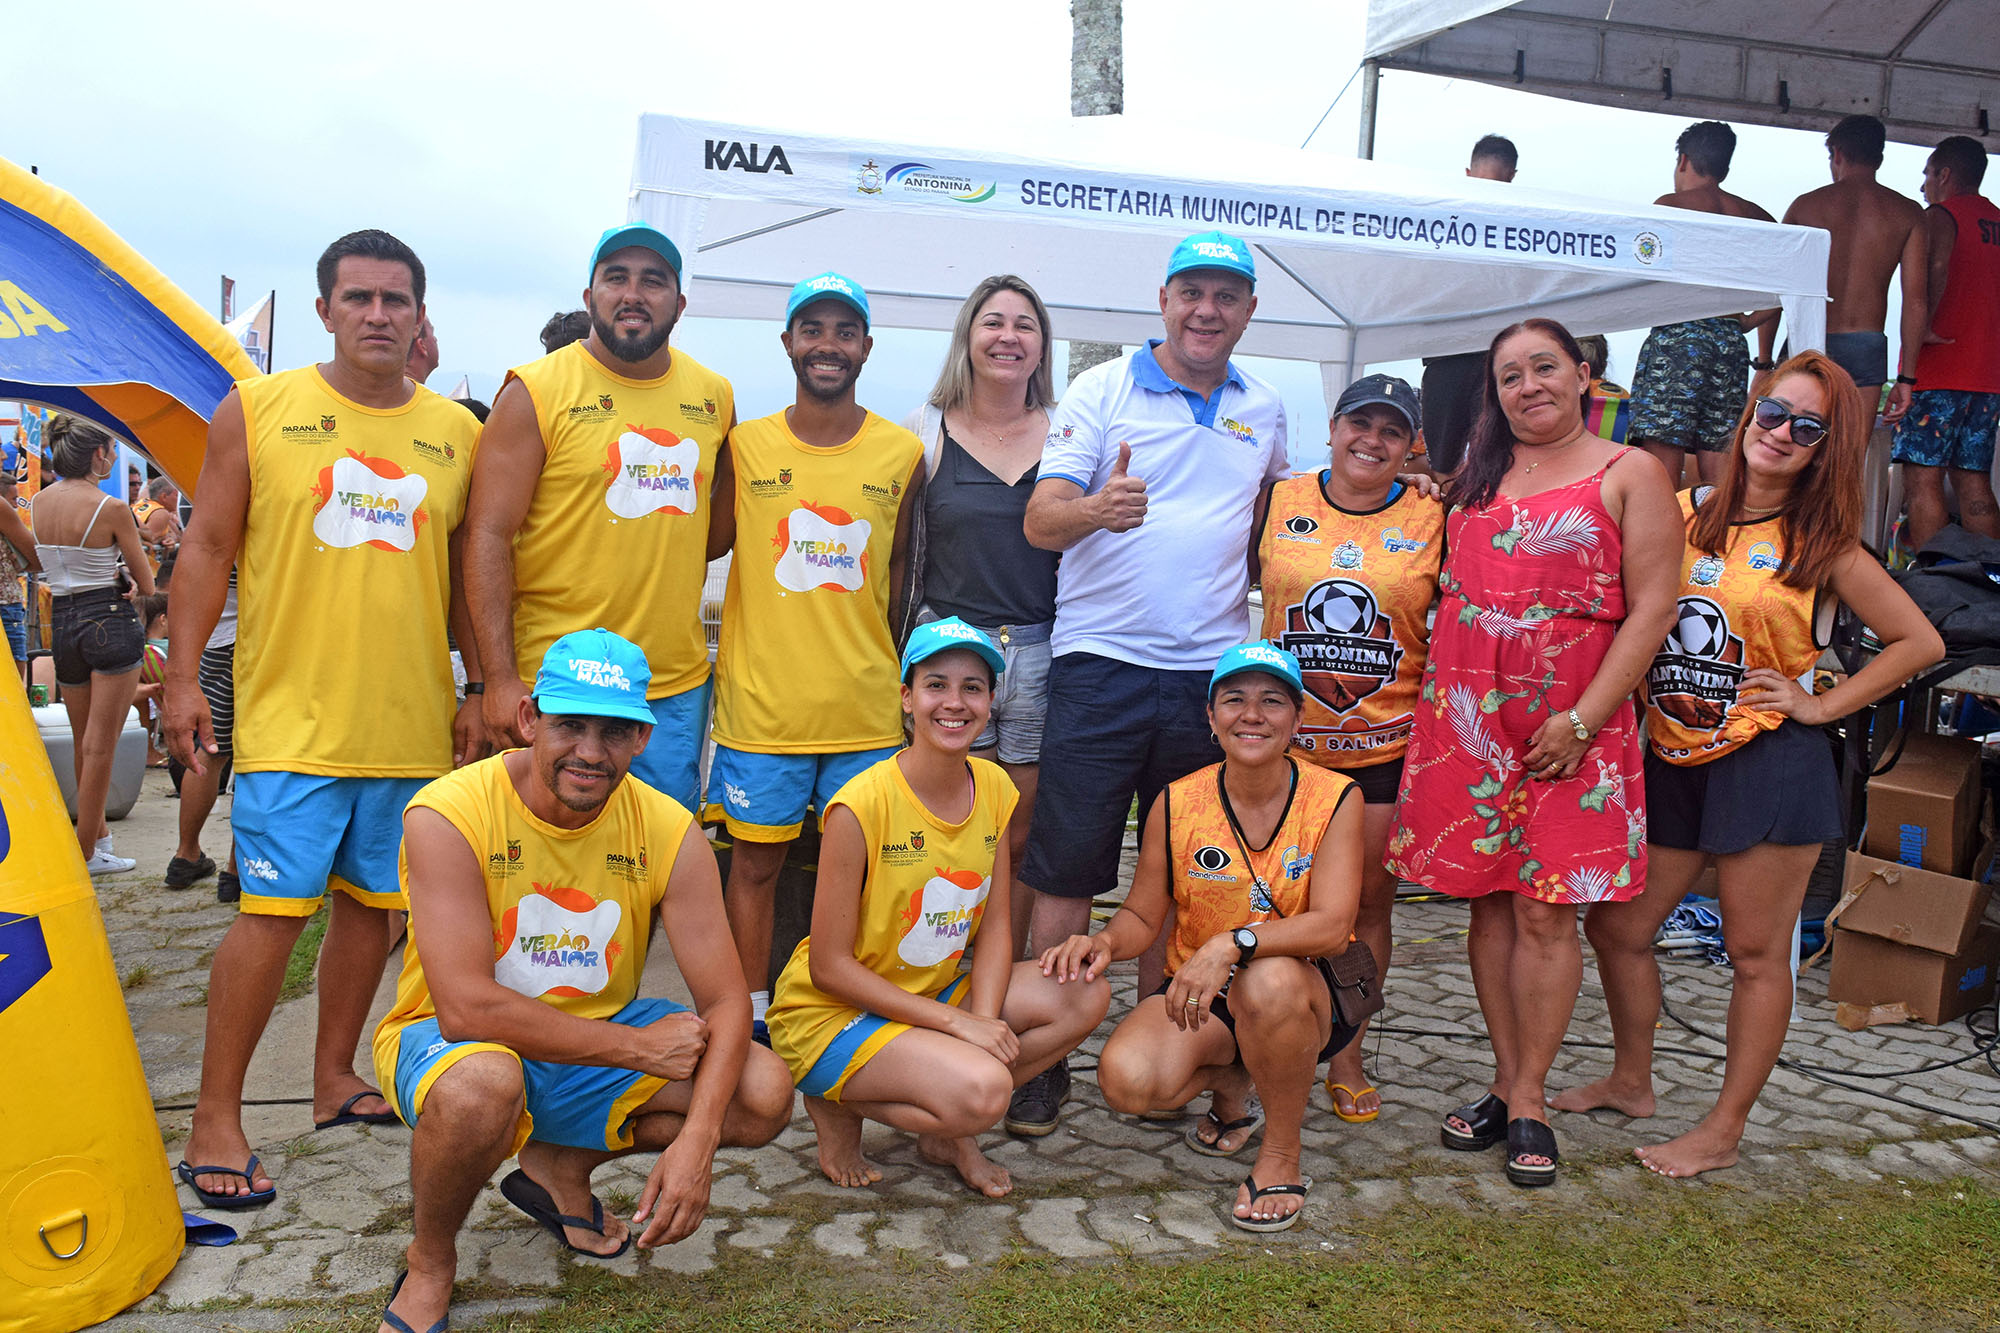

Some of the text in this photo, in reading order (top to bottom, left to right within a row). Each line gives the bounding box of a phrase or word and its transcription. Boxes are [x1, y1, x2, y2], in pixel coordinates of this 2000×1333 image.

[704, 139, 793, 175] KALA
[904, 177, 972, 192] ANTONINA
[1020, 178, 1174, 218] SECRETARIA
[1182, 195, 1308, 231] MUNICIPAL
[1315, 208, 1345, 235] DE
[1352, 212, 1477, 249] EDUCAÇÃO
[1484, 225, 1497, 248] E
[1504, 226, 1616, 259] ESPORTES
[1199, 247, 1240, 262] MAIOR
[569, 403, 599, 414] PARANÁ
[282, 424, 318, 433] PARANÁ
[1221, 416, 1254, 436] VERÃO
[413, 439, 443, 454] PARANÁ
[1228, 429, 1258, 448] MAIOR
[626, 458, 681, 478] VERÃO
[637, 477, 690, 491] MAIOR
[751, 477, 777, 486] PARANÁ
[863, 483, 888, 494] PARANÁ
[338, 490, 399, 511] VERÃO
[350, 507, 407, 528] MAIOR
[793, 537, 848, 555] VERÃO
[805, 553, 855, 569] MAIOR
[1324, 637, 1353, 645] OPEN
[1289, 643, 1389, 665] ANTONINA
[569, 656, 623, 677] VERÃO
[1321, 661, 1373, 672] FUTEVÔLEI
[576, 671, 630, 691] MAIOR
[1652, 664, 1734, 689] ANTONINA
[881, 842, 909, 852] ARANÁ
[935, 920, 972, 938] MAIO
[520, 926, 590, 953] VERÃO
[531, 950, 599, 968] MAIOR
